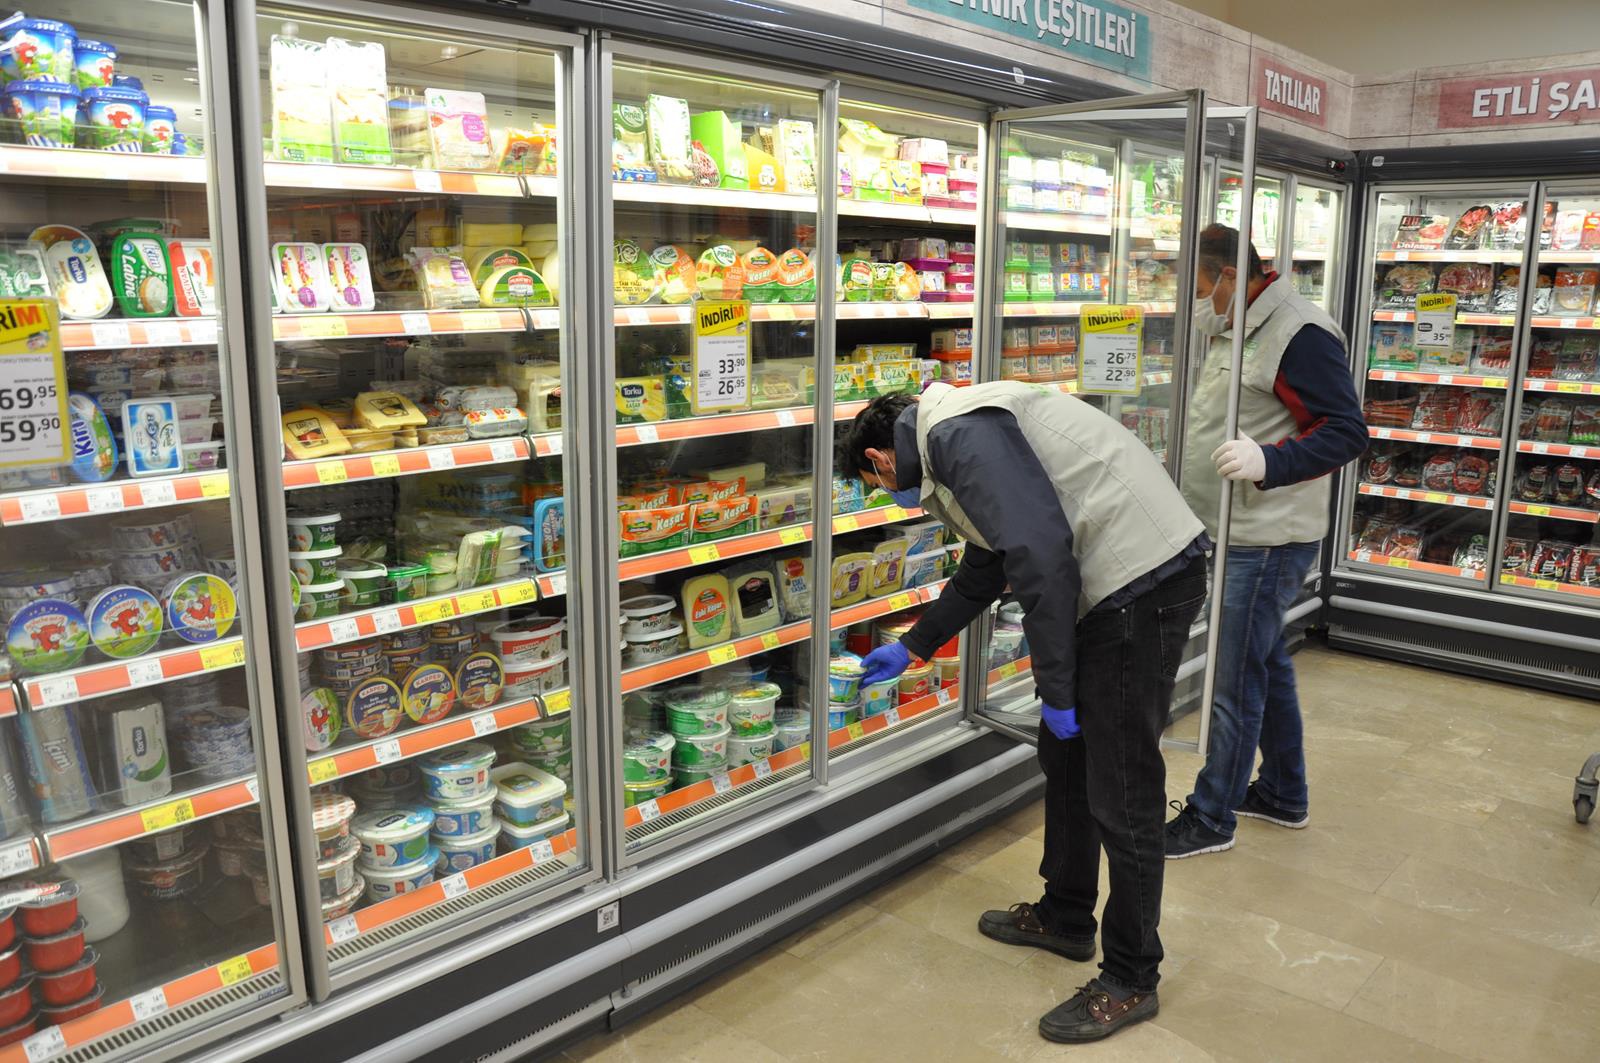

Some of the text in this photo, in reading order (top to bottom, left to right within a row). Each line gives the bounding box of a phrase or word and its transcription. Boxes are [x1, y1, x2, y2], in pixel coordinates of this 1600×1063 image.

[1264, 69, 1321, 115] TATLILAR
[1472, 77, 1600, 119] ETLİ ŞA
[69, 257, 86, 284] Torku
[122, 255, 139, 298] Labne
[1420, 296, 1452, 308] İNDİRİM
[700, 304, 744, 329] İNDİRİM
[623, 386, 642, 396] Torku
[72, 420, 95, 458] Kiri
[712, 482, 739, 502] Kaşar
[656, 511, 685, 531] Kaşar
[723, 501, 750, 520] Kaşar
[137, 729, 145, 753] Torku
